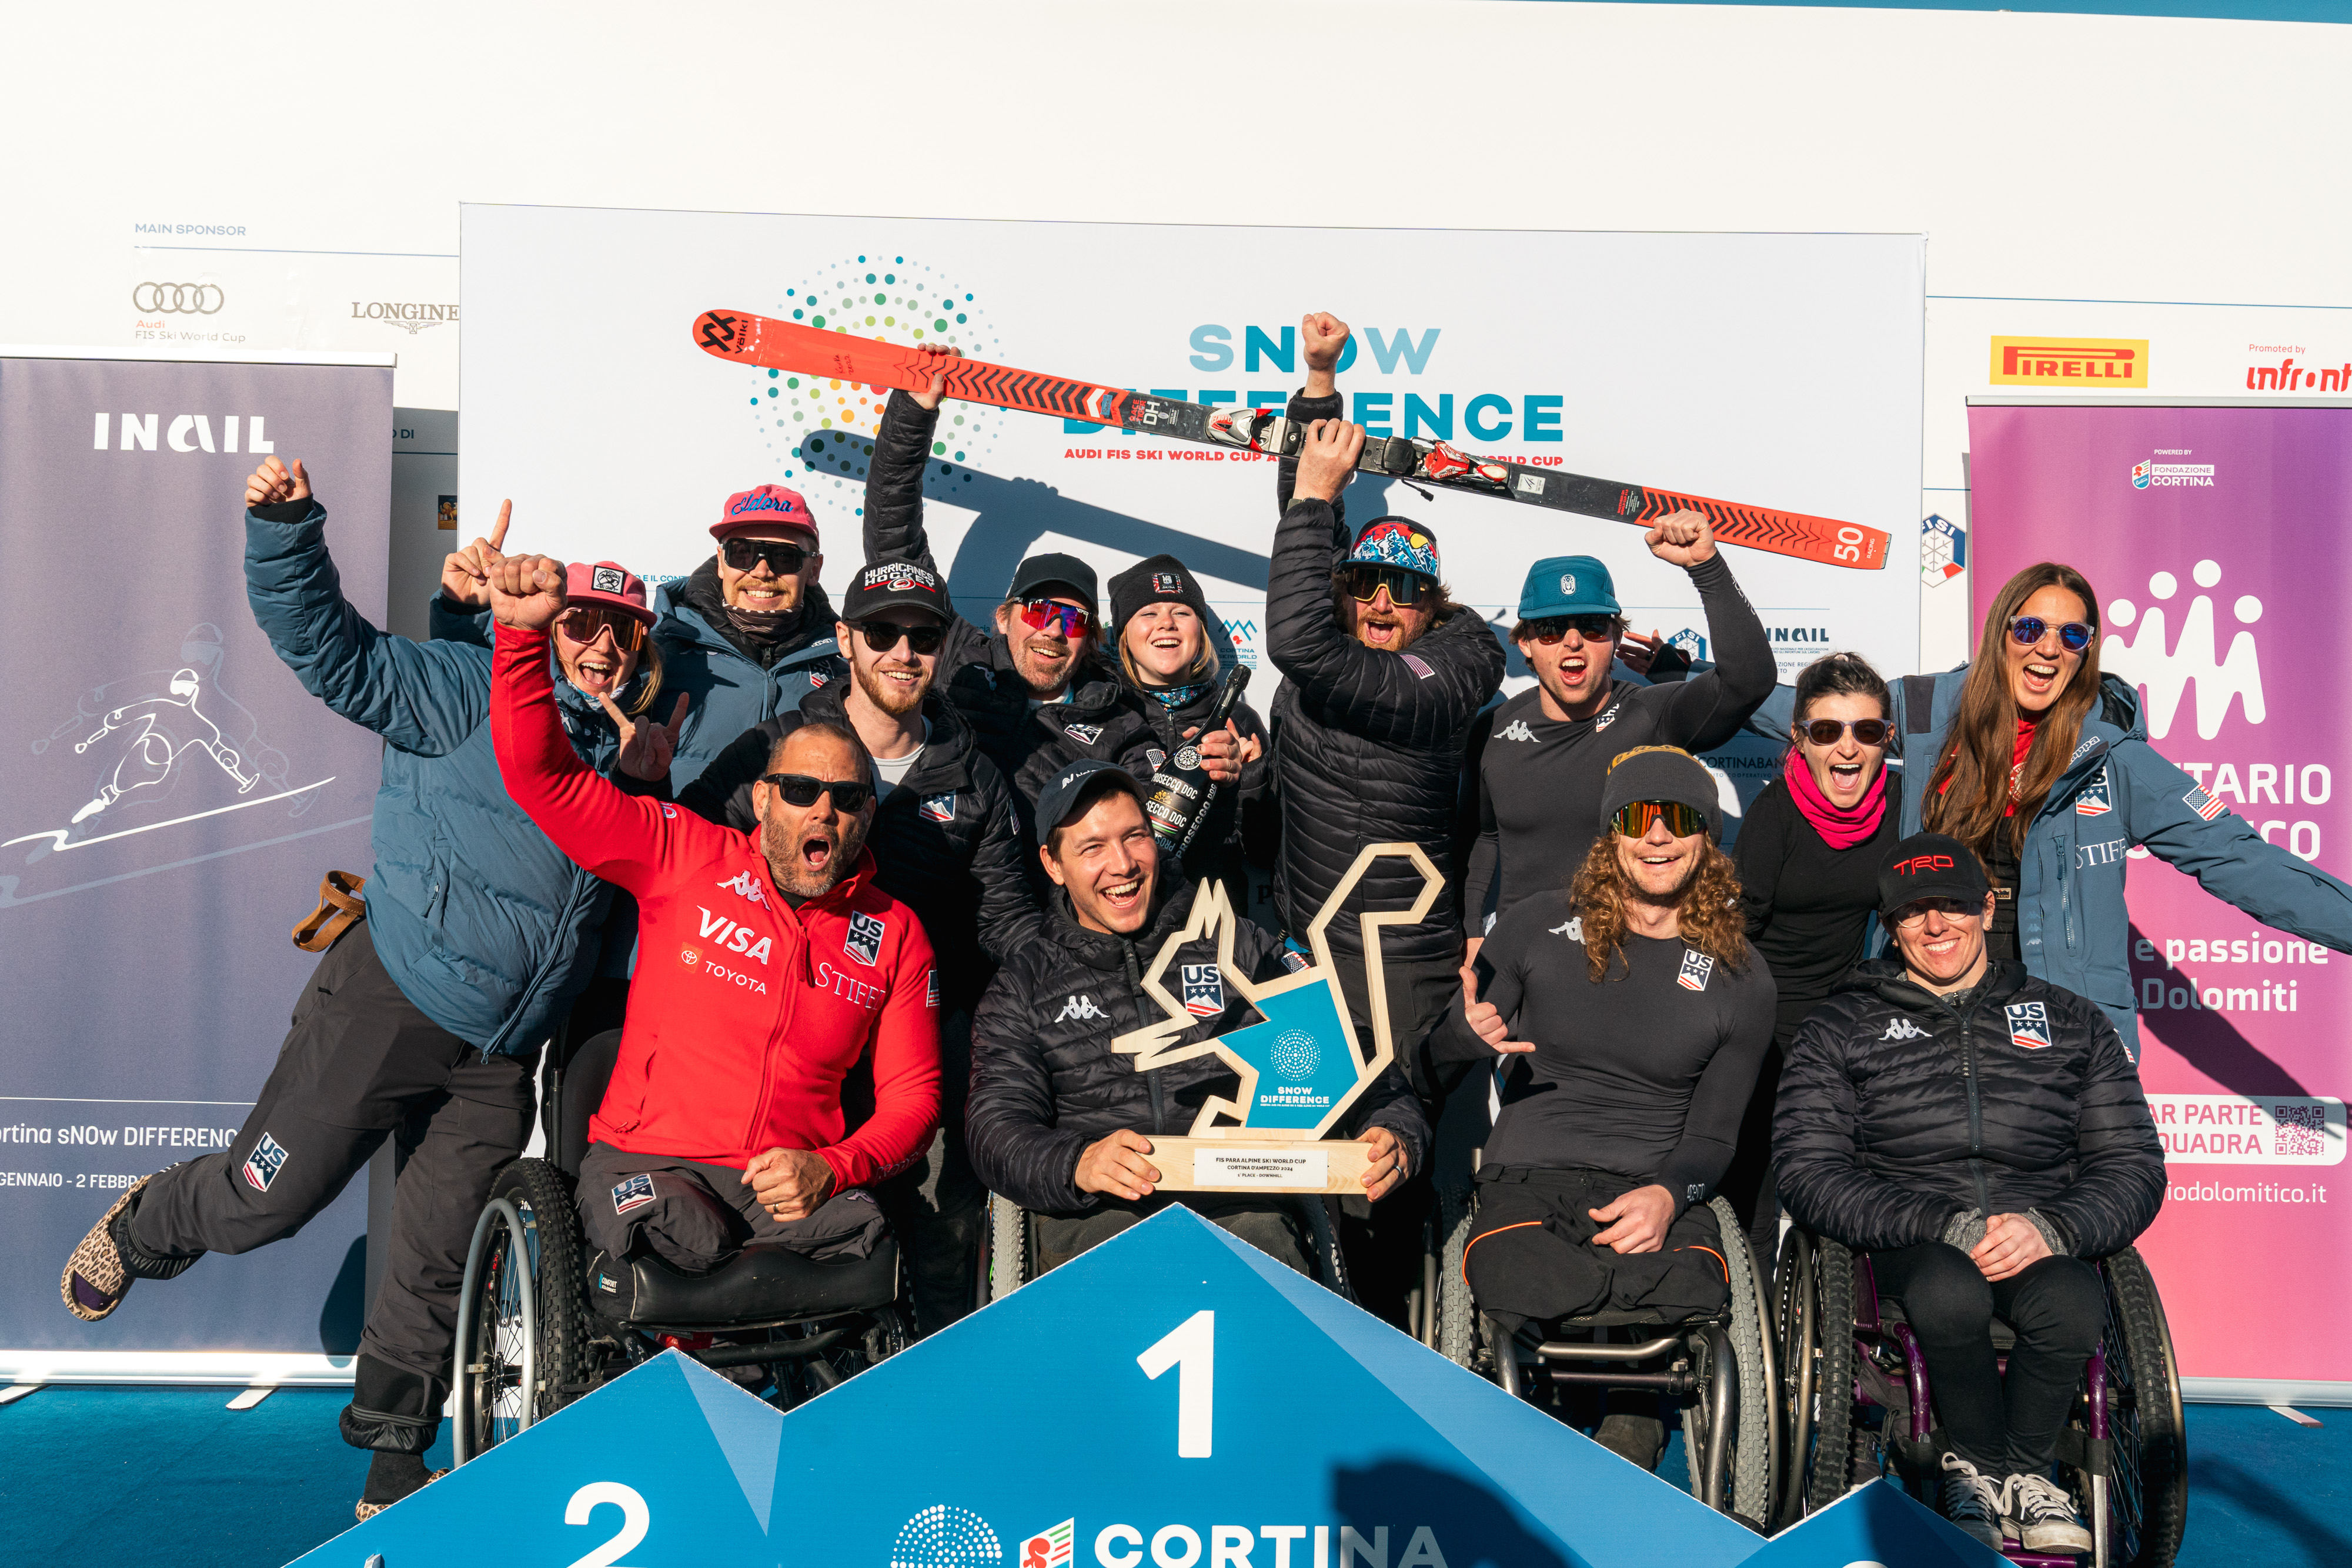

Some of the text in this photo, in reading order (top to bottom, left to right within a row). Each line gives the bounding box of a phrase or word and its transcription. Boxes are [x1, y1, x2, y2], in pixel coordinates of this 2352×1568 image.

[135, 223, 246, 236] MAIN SPONSOR
[136, 320, 165, 329] Audi
[135, 330, 246, 343] FIS Ski World Cup
[2249, 344, 2306, 355] Promoted by
[2003, 346, 2136, 379] PIRELLI
[1130, 399, 1140, 422] RACE
[1135, 400, 1147, 422] TIGER
[1142, 401, 1161, 426] DH
[93, 412, 275, 454] INAIL
[400, 429, 414, 439] DI
[1064, 449, 1101, 459] AUDI
[1107, 449, 1131, 460] FIS
[1136, 450, 1163, 460] SKI
[1167, 450, 1225, 462] WORLD
[1229, 452, 1262, 463] CUP
[1531, 456, 1563, 466] CUP
[2151, 476, 2214, 487] CORTINA
[730, 493, 794, 517] Eldora
[1833, 526, 1863, 563] 50
[1866, 538, 1876, 559] RACING
[864, 562, 935, 583] HURRICANES
[864, 571, 935, 587] HOCKEY
[1675, 631, 1700, 642] FISI
[1766, 627, 1829, 643] INAIL
[1151, 773, 1198, 800] PROSECCO DOC
[2173, 762, 2331, 805] TARIO
[1168, 811, 1187, 828] DOC
[1175, 783, 1217, 859] PROSECCO DOC
[1893, 855, 1954, 875] TRD
[696, 905, 773, 965] VISA
[852, 912, 883, 938] US
[1685, 951, 1713, 969] US
[2134, 931, 2328, 970] e passione
[706, 961, 767, 996] TOYOTA
[1184, 965, 1220, 984] US
[2141, 977, 2297, 1012] Dolomiti
[2007, 1004, 2044, 1019] US
[1260, 1095, 1329, 1104] DIFFERENCE
[1277, 1086, 1313, 1095] SNOW
[2184, 1104, 2263, 1125] PARTE
[58, 1125, 118, 1146] sNOw
[258, 1134, 287, 1166] US
[76, 1174, 86, 1188] 2
[613, 1174, 650, 1197] US
[602, 1276, 617, 1288] COMFORT
[1136, 1310, 1215, 1459] 1
[564, 1482, 650, 1568] 2
[1094, 1523, 1449, 1568] CORTINA
